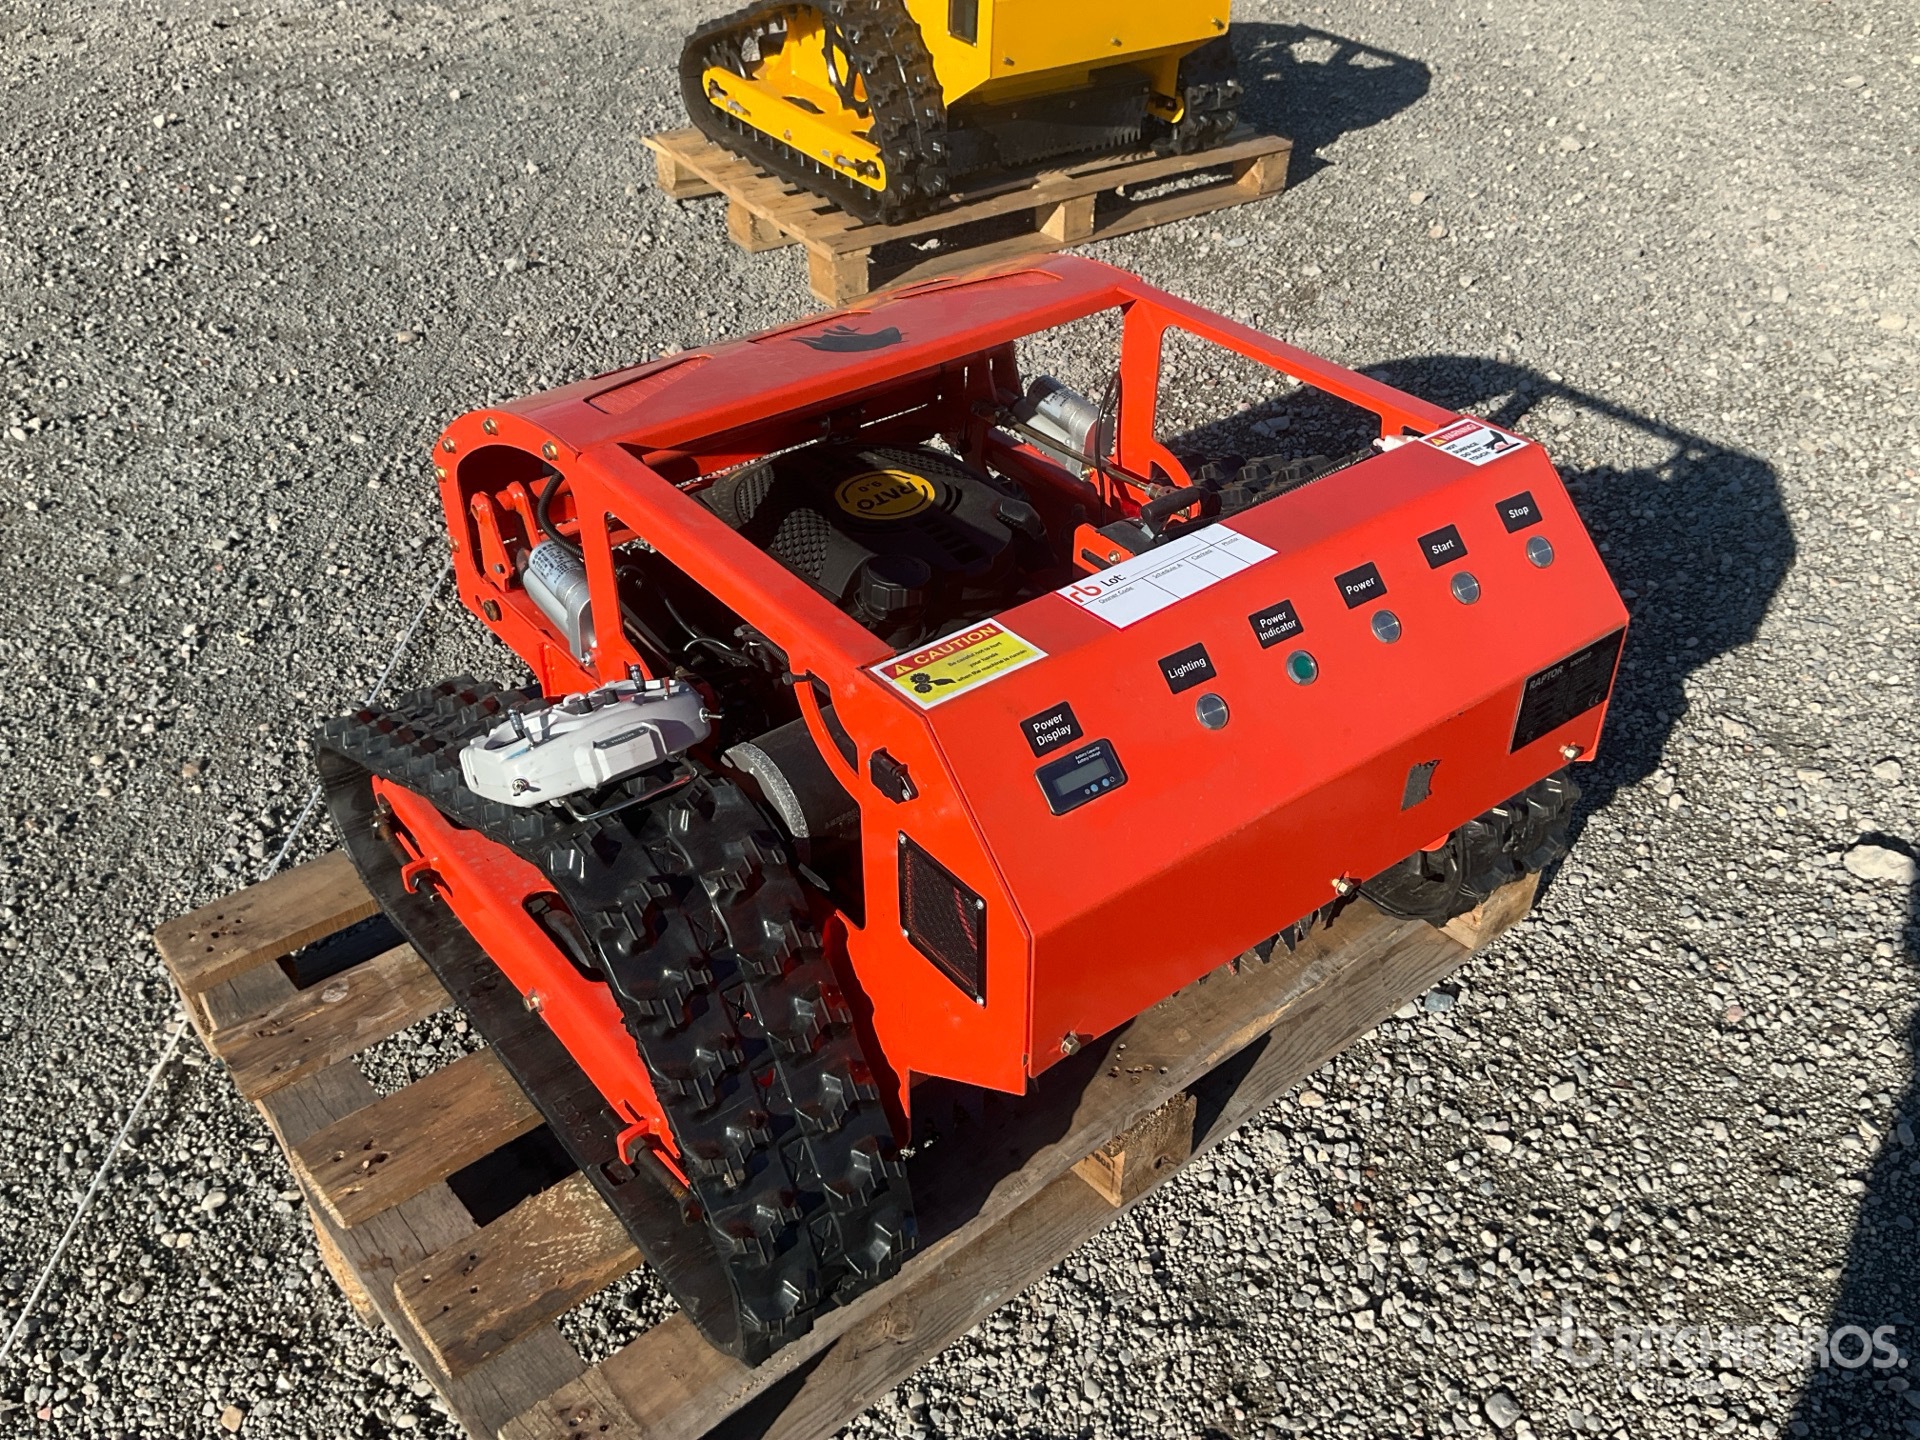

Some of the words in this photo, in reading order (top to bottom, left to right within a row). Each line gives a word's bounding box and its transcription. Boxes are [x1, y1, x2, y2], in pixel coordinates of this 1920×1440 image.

[1452, 442, 1480, 454] SURFACE
[857, 481, 918, 510] RATO
[1508, 504, 1530, 520] Stop
[1431, 539, 1455, 555] Start
[1069, 584, 1102, 603] rb
[1345, 577, 1376, 595] Power
[1259, 610, 1287, 629] Power
[1259, 618, 1297, 641] Indicator
[914, 625, 996, 665] CAUTION
[1168, 656, 1207, 680] Lighting
[1529, 665, 1564, 690] RAPTOR
[1032, 713, 1063, 734] Power
[1036, 724, 1072, 746] Display
